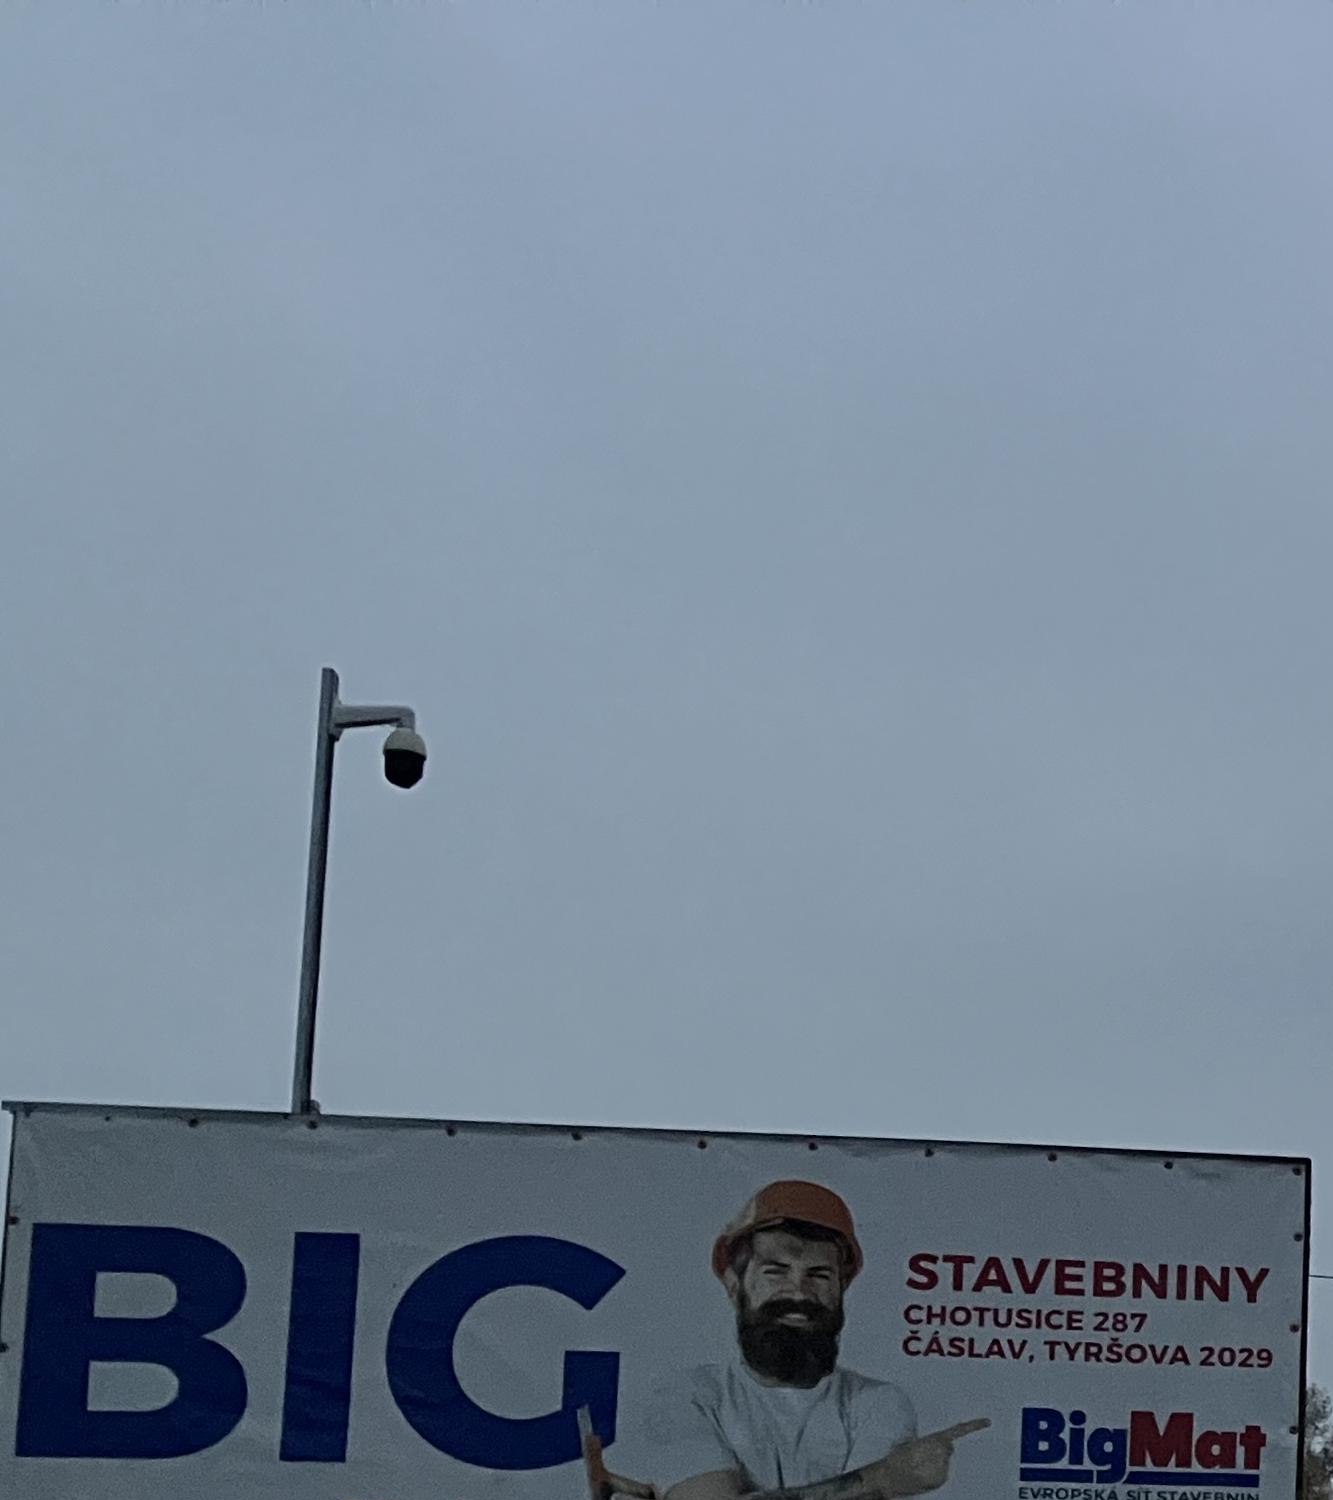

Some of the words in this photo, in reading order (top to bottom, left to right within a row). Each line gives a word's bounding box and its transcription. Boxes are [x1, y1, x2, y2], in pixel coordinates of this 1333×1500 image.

[905, 1252, 1271, 1304] STAVEBNINY
[903, 1303, 1084, 1332] CHOTUSICE
[1093, 1312, 1148, 1333] 287
[15, 1221, 627, 1471] BIG
[901, 1329, 1035, 1364] ČÁSLAV,
[1043, 1338, 1191, 1366] TYRŠOVA
[1199, 1346, 1274, 1369] 2029
[1020, 1407, 1267, 1485] BigMat
